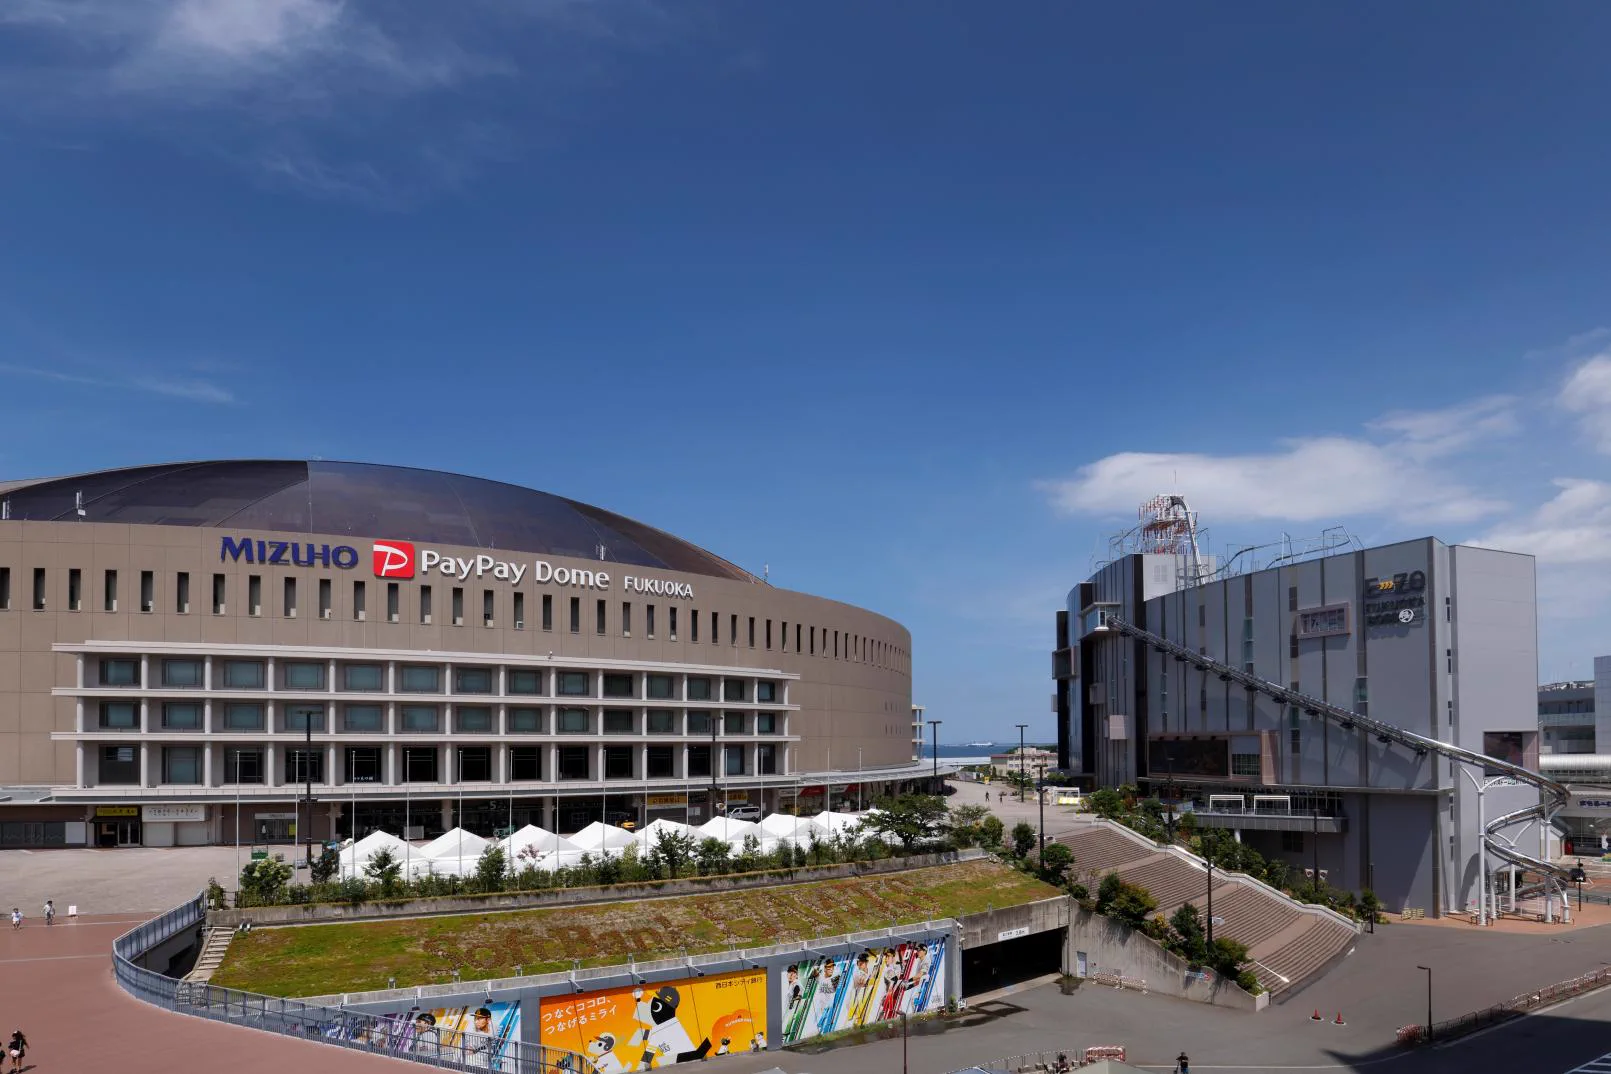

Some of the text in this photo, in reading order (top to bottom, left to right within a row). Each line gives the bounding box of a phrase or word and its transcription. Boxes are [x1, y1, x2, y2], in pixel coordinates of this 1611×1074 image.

[220, 536, 359, 570] MIZUHO
[421, 550, 527, 584] PayPay
[535, 560, 611, 589] Dome
[624, 575, 694, 599] FUKUOKA
[715, 977, 763, 989] 西日本シティ銀行
[542, 996, 611, 1022] つなぐココロ、
[545, 1004, 617, 1035] つなげるミライ
